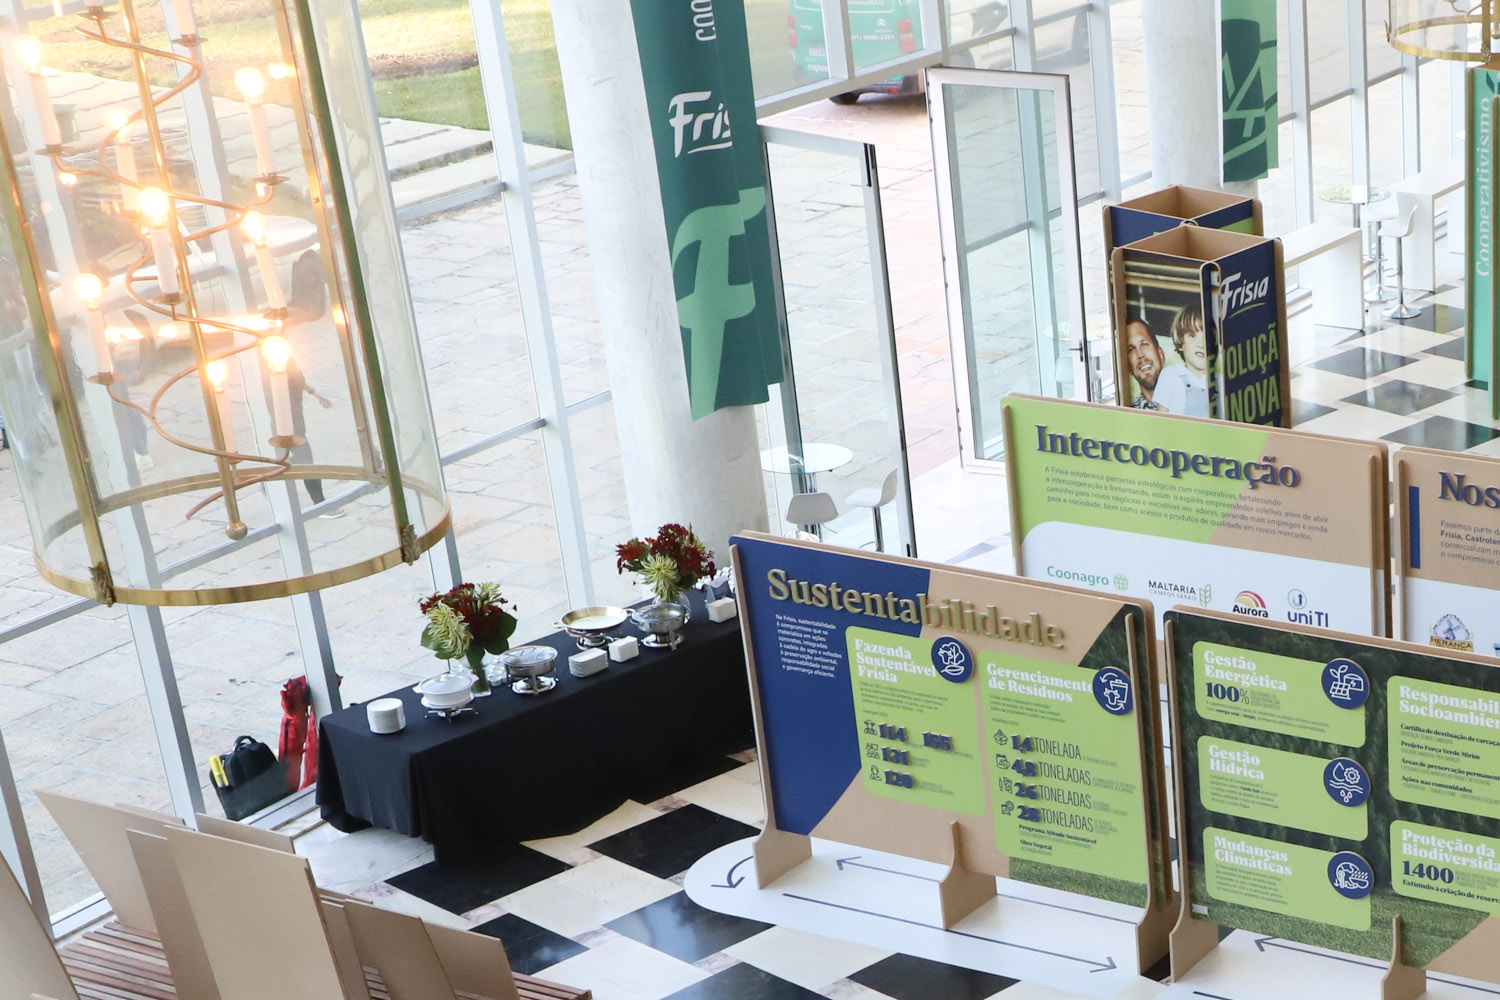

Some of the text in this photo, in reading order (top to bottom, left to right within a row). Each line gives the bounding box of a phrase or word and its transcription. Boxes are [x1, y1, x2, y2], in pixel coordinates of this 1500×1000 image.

[1034, 424, 1301, 489] Intercooperação
[1047, 566, 1109, 586] Coonagro
[1149, 580, 1196, 595] MALTARIA
[767, 568, 1064, 650] Sustentabilidade
[1233, 605, 1268, 618] Aurora
[1288, 610, 1328, 627] uniTI
[854, 638, 912, 660] Fazenda
[856, 652, 937, 678] Sustentável
[1204, 650, 1256, 672] Gestão
[1205, 664, 1288, 692] Energética
[988, 678, 1073, 703] de Resíduos
[1206, 682, 1250, 705] 100%
[1400, 723, 1425, 733] Cartilha
[1434, 729, 1467, 741] destinação
[1034, 736, 1081, 761] TONELADA
[1208, 744, 1260, 766] Gestão
[1401, 740, 1480, 760] Projeto Força Verde Mirim
[1038, 761, 1092, 786] TONELADAS
[1210, 758, 1265, 780] Hídrica
[1428, 762, 1465, 775] preservação
[1401, 775, 1419, 784] Ações
[1432, 781, 1472, 793] comunidades
[1038, 785, 1092, 810] TONELADAS
[1041, 807, 1094, 833] TONELADAS
[1214, 835, 1288, 862] Mudanças
[1402, 829, 1495, 858] Proteção da
[1215, 848, 1293, 876] Climáticas
[1440, 886, 1466, 897] criação
[1467, 891, 1476, 899] de
